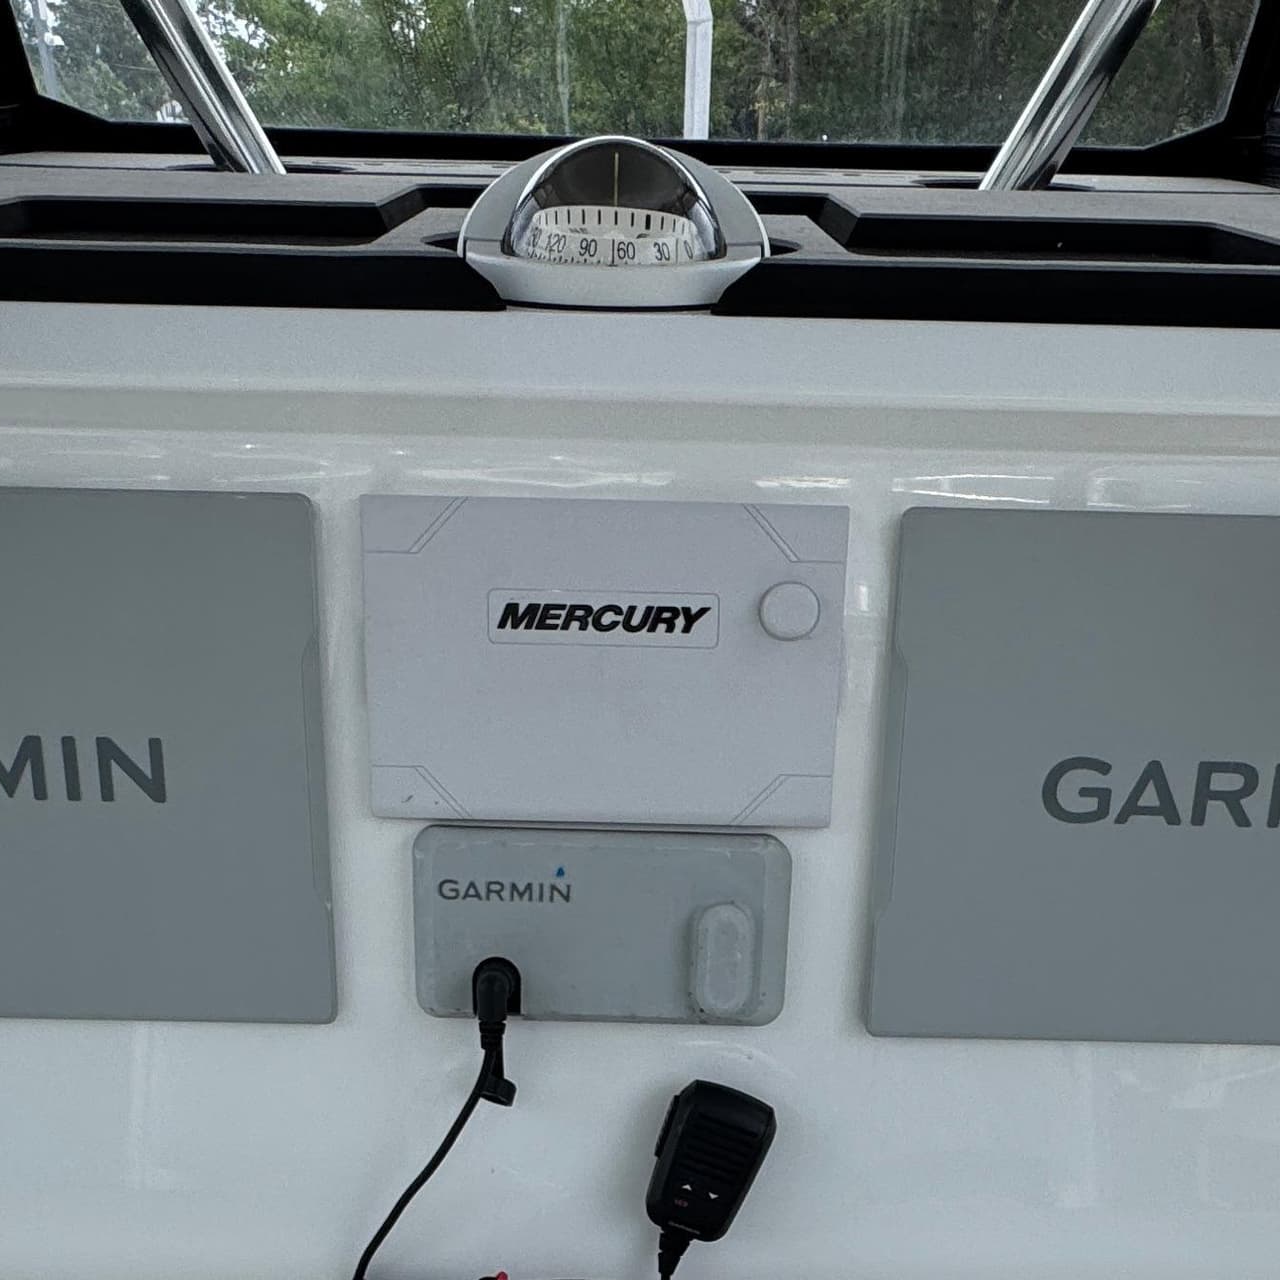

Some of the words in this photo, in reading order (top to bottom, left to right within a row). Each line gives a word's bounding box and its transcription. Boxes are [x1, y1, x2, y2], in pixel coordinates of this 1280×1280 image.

[579, 238, 598, 258] 90
[617, 241, 636, 261] 60
[653, 242, 671, 262] 30
[497, 602, 711, 635] MERCURY
[438, 878, 572, 904] GARMIN
